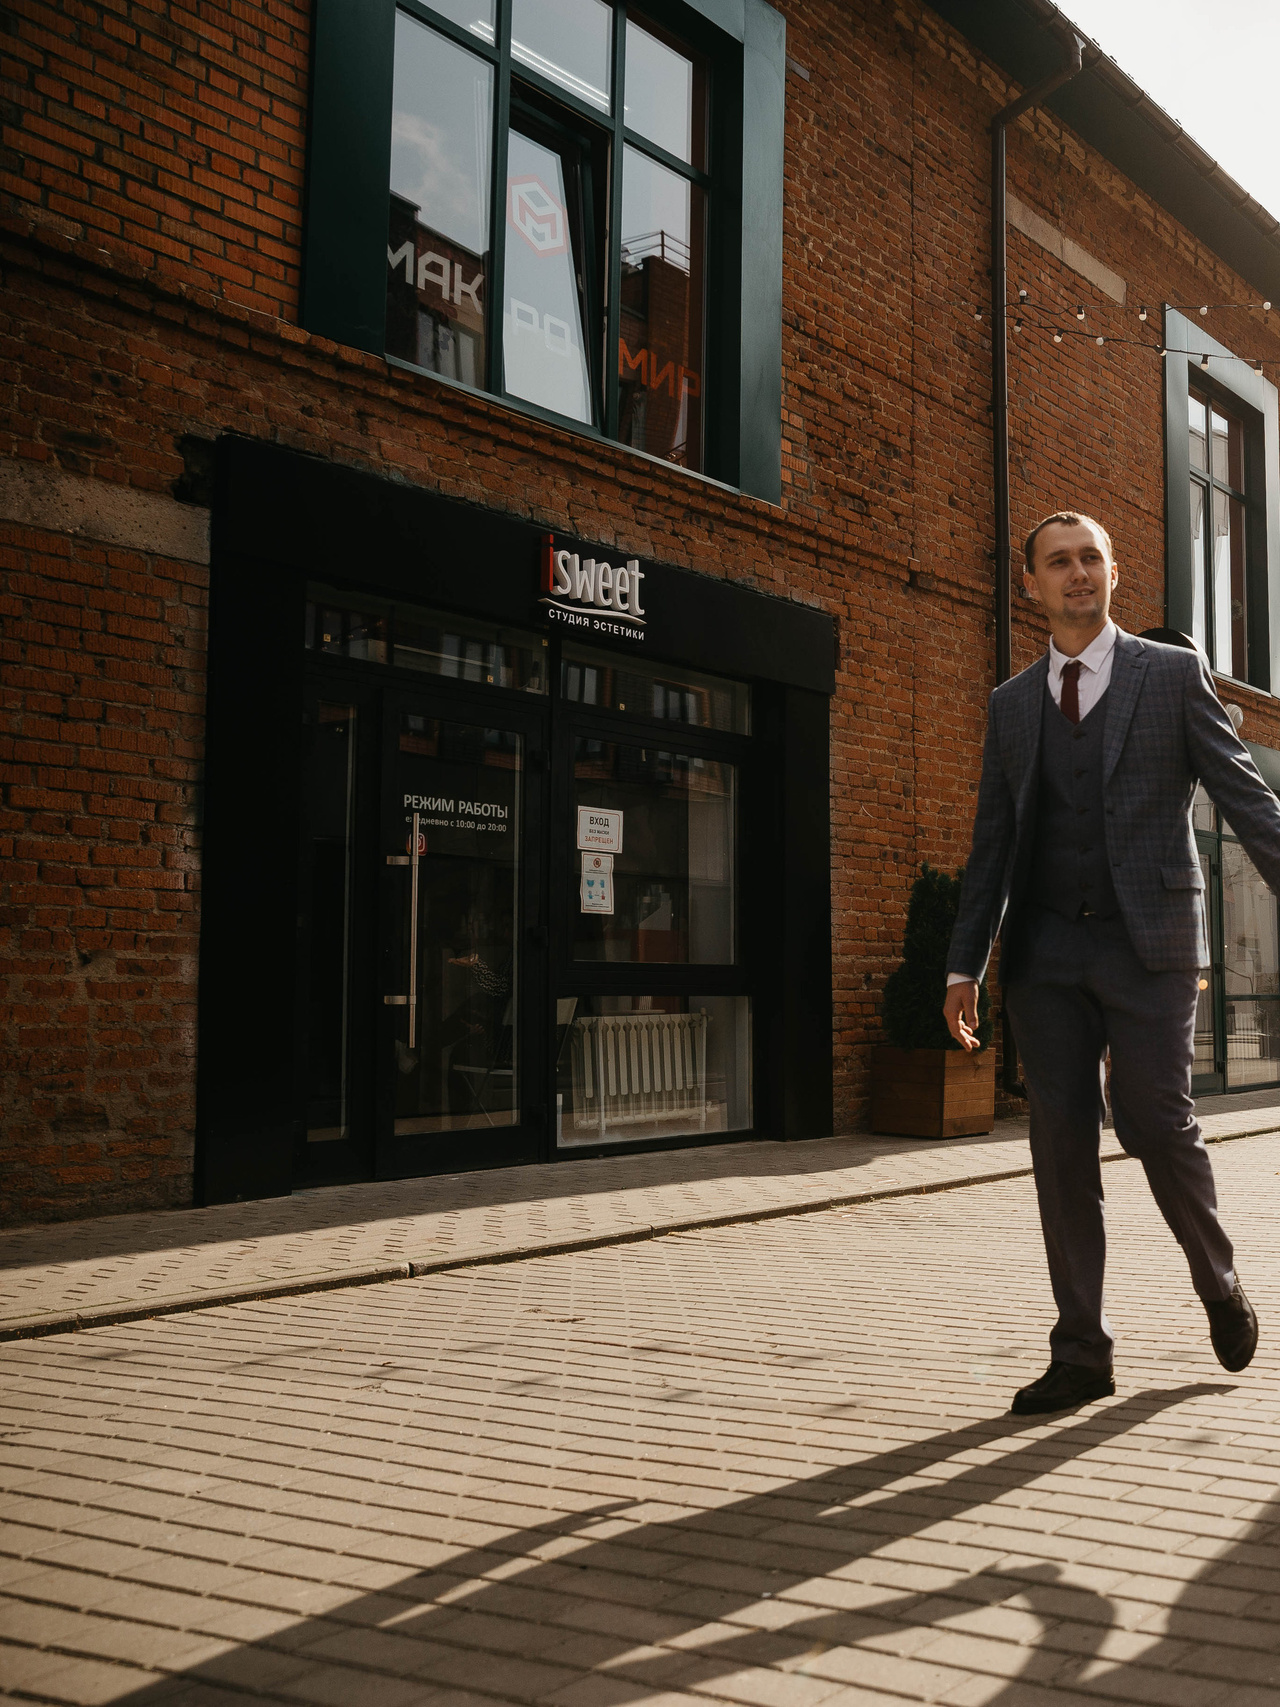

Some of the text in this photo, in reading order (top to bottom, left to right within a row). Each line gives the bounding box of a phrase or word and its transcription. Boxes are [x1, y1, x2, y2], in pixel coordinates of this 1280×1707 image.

[618, 336, 701, 401] МИР
[548, 609, 645, 640] СТУДИЯ ЭСТЕТИКИ
[403, 794, 508, 819] РЕЖИМ РАБОТЫ
[405, 816, 449, 827] едневно
[456, 820, 476, 829] 10:00
[476, 823, 486, 831] до
[488, 823, 507, 832] 20:00
[589, 816, 610, 828] ВХОД
[585, 835, 614, 845] ЗАПРЕЩЕН
